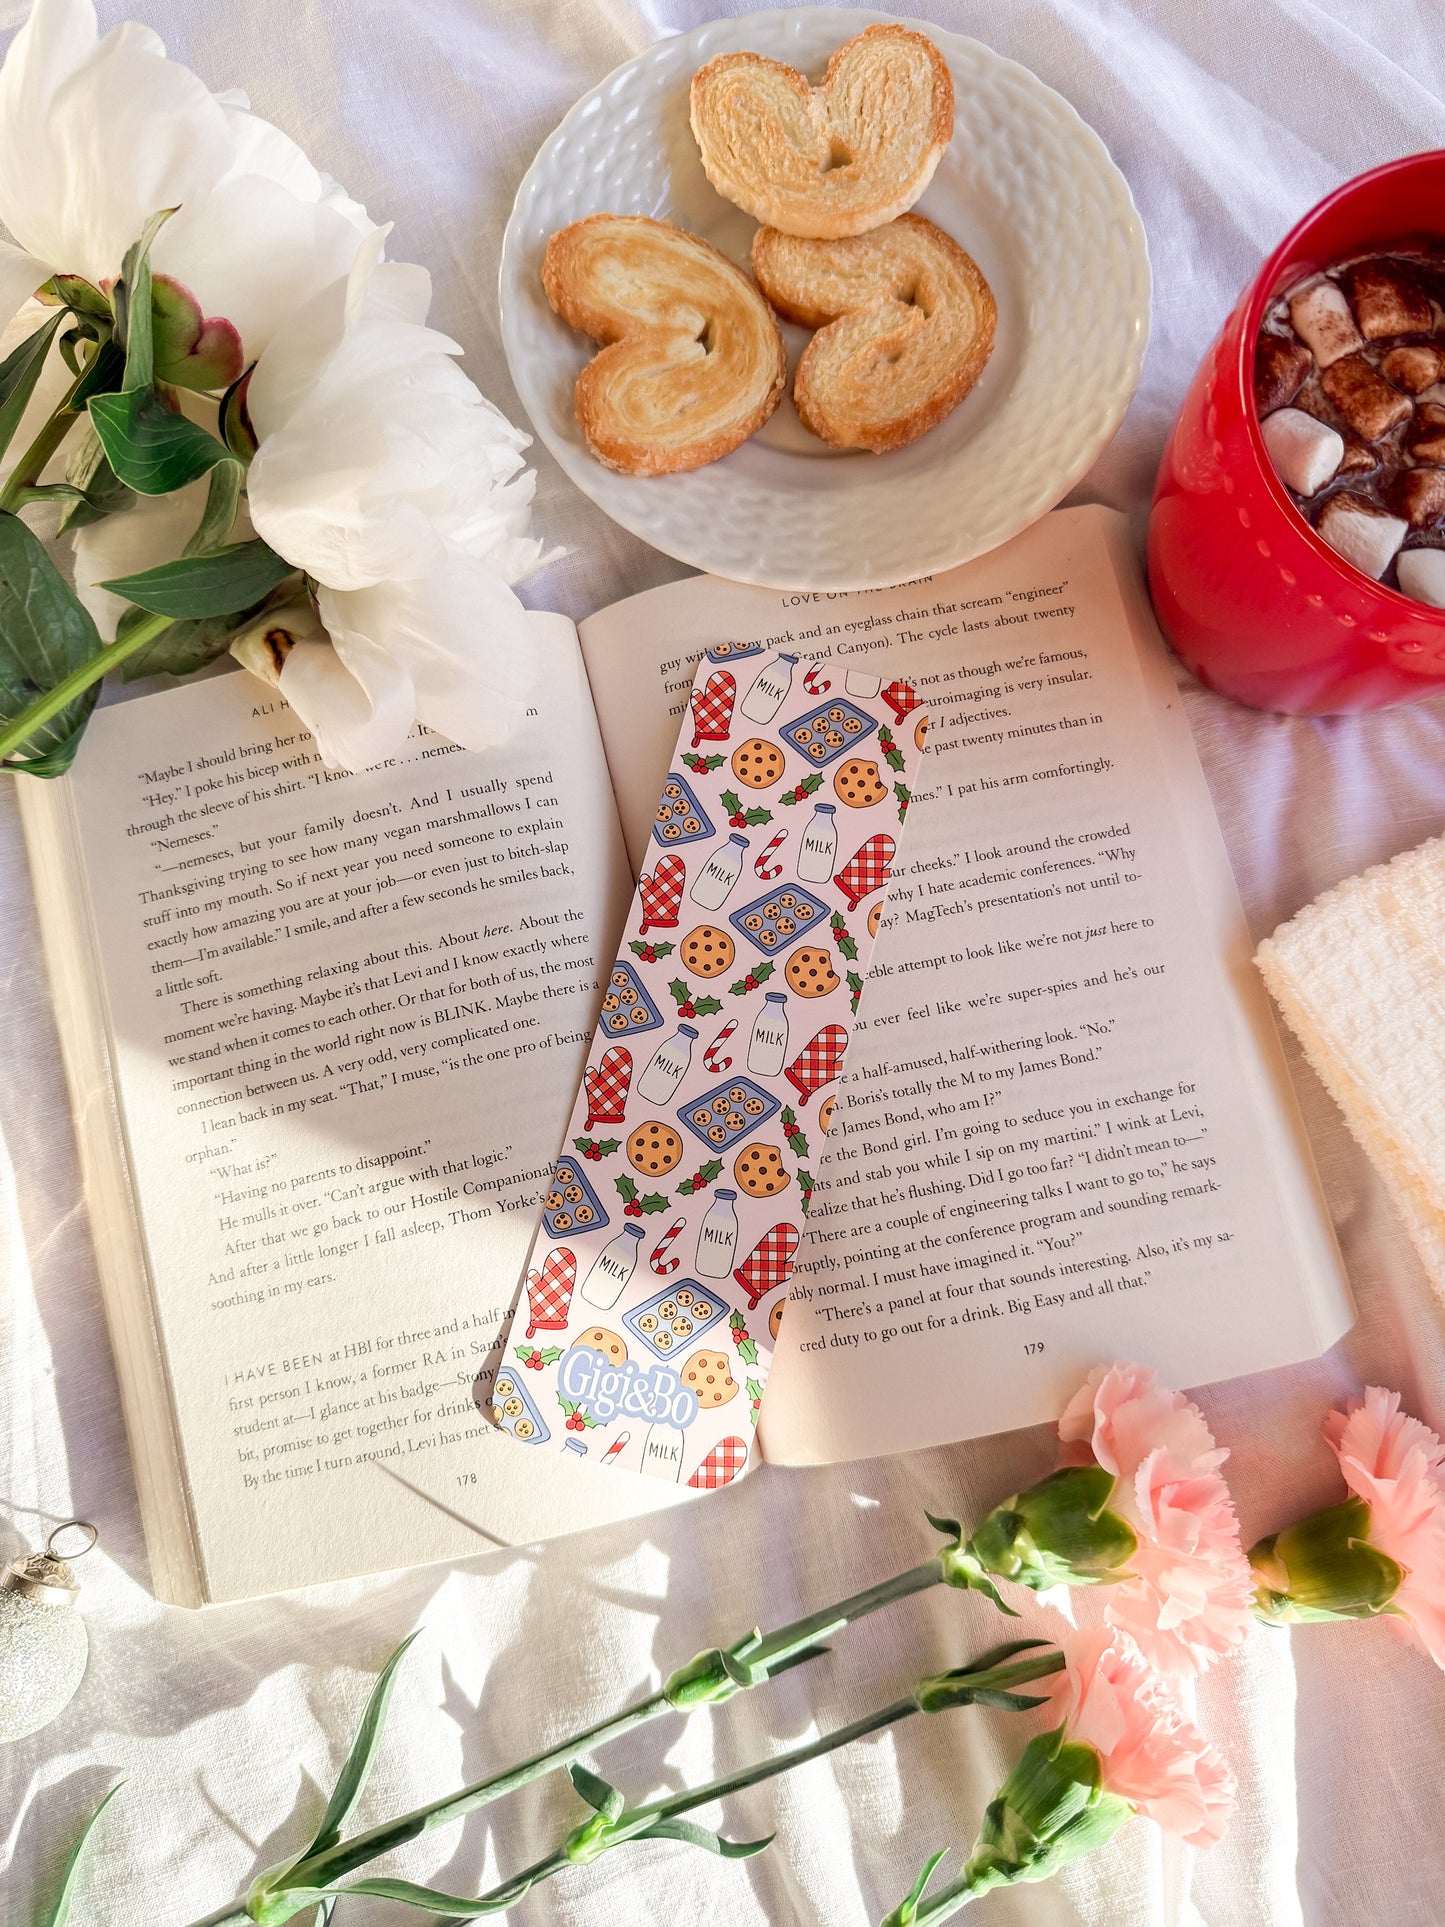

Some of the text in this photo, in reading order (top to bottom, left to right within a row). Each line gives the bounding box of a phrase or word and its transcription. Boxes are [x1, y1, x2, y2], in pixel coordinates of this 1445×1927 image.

[782, 592, 820, 608] LOVE
[766, 630, 795, 649] pack
[799, 625, 822, 639] and
[826, 626, 841, 635] an
[844, 616, 892, 633] eyeglass
[896, 610, 929, 622] chain
[932, 603, 957, 615] that
[960, 597, 1003, 610] scream
[920, 675, 940, 685] not
[943, 672, 955, 681] as
[958, 661, 1002, 678] though
[1039, 650, 1087, 664] famous,
[756, 678, 784, 700] MILK
[252, 703, 274, 718] ALI
[941, 710, 1011, 728] I adjectives.
[187, 761, 193, 772] I
[197, 748, 236, 770] should
[239, 743, 273, 758] bring
[275, 736, 295, 748] her
[299, 732, 311, 741] to
[934, 715, 1103, 756] past twenty minutes than in
[947, 757, 1114, 798] I pat his arm comfortingly.
[138, 798, 558, 904] Thanksgiving trying to see how many vegan marshmallows I can
[806, 838, 833, 855] MILK
[706, 863, 734, 886] MILK
[887, 888, 913, 902] why
[918, 884, 923, 896] I
[927, 882, 955, 894] hate
[959, 871, 1016, 888] academic
[1020, 858, 1095, 877] conferences.
[1065, 882, 1086, 893] not
[1090, 872, 1120, 888] until
[1124, 874, 1142, 882] to-
[148, 931, 188, 950] exactly
[192, 925, 218, 939] how
[222, 910, 276, 930] amazing
[279, 903, 301, 916] you
[305, 897, 324, 908] are
[329, 892, 339, 902] at
[343, 884, 371, 902] your
[431, 864, 460, 876] even
[465, 857, 488, 872] just
[492, 854, 505, 863] to
[507, 841, 568, 860] bitch-slap
[180, 909, 583, 1014] There is something relaxing about this. About here. About the
[756, 1028, 784, 1046] MILK
[654, 1055, 683, 1078] MILK
[892, 1080, 932, 1098] totally
[936, 1076, 957, 1090] the
[961, 1071, 975, 1085] M
[979, 1073, 992, 1081] to
[995, 1068, 1014, 1078] my
[1019, 1060, 1057, 1076] James
[219, 1216, 239, 1231] He
[242, 1206, 277, 1225] mulls
[280, 1206, 288, 1216] it
[292, 1199, 321, 1212] over.
[368, 1177, 405, 1194] argue
[409, 1165, 439, 1182] with
[443, 1160, 469, 1174] that
[851, 1226, 871, 1237] are
[875, 1223, 882, 1232] a
[886, 1210, 929, 1229] couple
[933, 1205, 946, 1220] of
[950, 1194, 1029, 1218] engineering
[1031, 1184, 1063, 1200] talks
[1066, 1181, 1072, 1194] I
[1076, 1178, 1109, 1191] want
[1112, 1176, 1124, 1185] to
[1128, 1172, 1144, 1184] go
[1171, 1160, 1188, 1173] he
[1191, 1158, 1216, 1169] says
[704, 1228, 733, 1246] MILK
[599, 1256, 629, 1281] MILK
[876, 1303, 884, 1312] a
[888, 1290, 925, 1314] panel
[929, 1291, 942, 1302] at
[946, 1285, 974, 1298] four
[979, 1278, 1006, 1292] that
[1010, 1265, 1056, 1284] sounds
[1060, 1254, 1131, 1275] interesting.
[1137, 1244, 1169, 1260] Also,
[1193, 1237, 1211, 1247] my
[1217, 1233, 1234, 1241] sa-
[225, 1309, 501, 1386] I HAVE BEEN at HBI for three and a half
[1024, 1342, 1044, 1355] 179
[563, 1351, 693, 1424] Gigi&Bo
[237, 1397, 481, 1462] bit, promise to get together for drinks
[649, 1442, 679, 1462] MILK
[456, 1473, 477, 1486] 178
